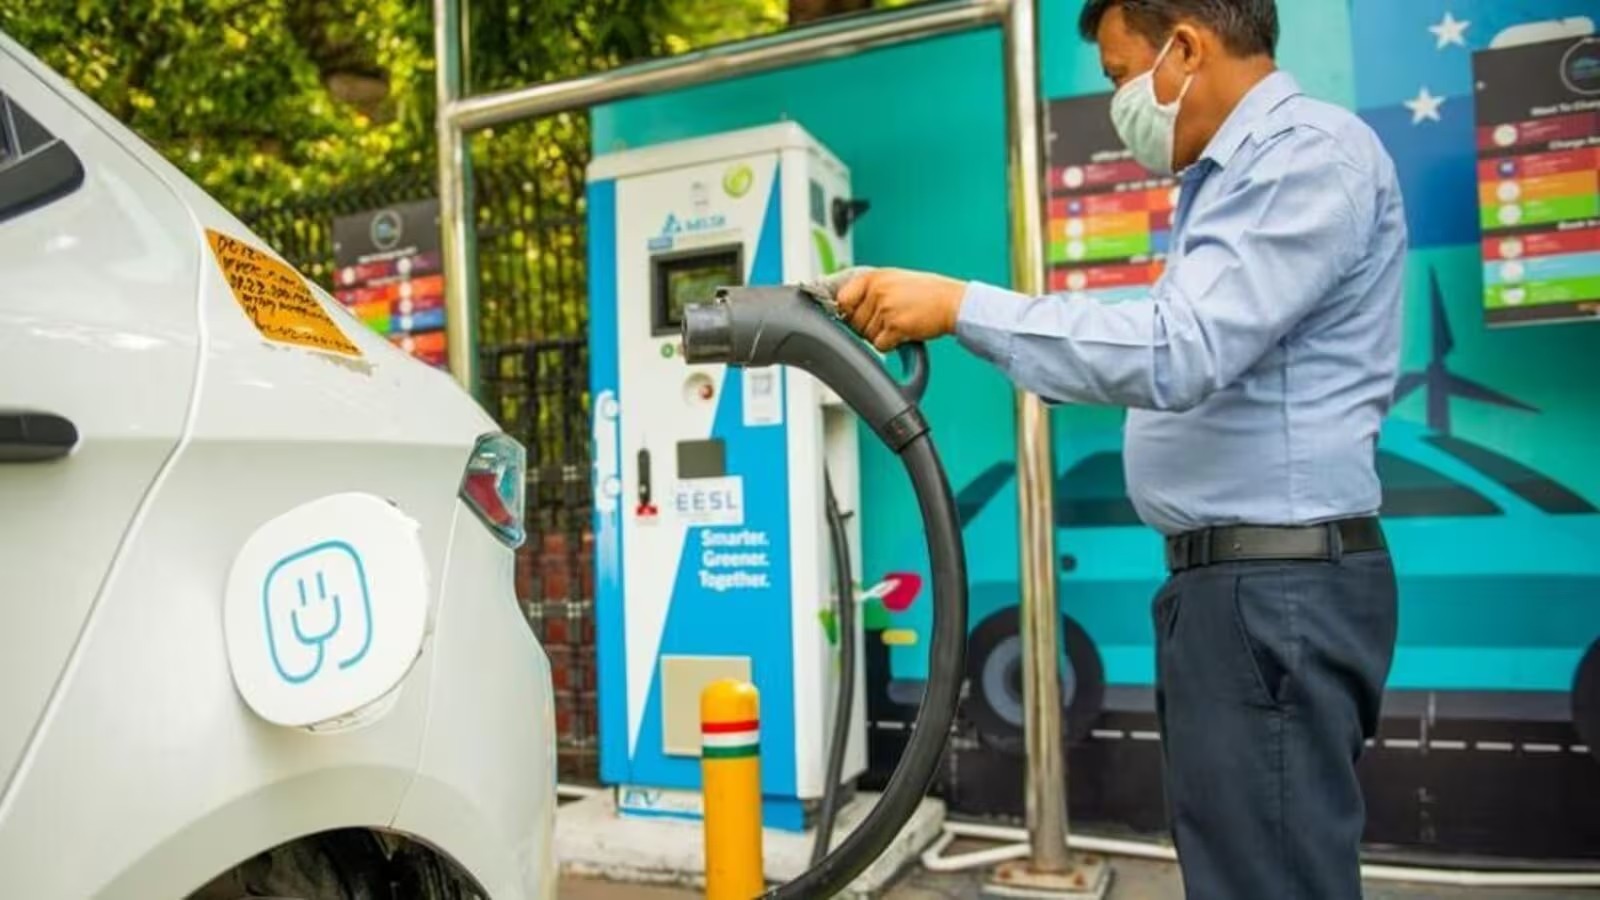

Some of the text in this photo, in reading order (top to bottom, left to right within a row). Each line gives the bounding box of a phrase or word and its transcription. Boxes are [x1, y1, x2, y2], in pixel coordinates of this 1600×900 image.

[676, 489, 737, 512] EESL
[701, 528, 770, 546] Smarter.
[703, 549, 770, 567] Greener.
[698, 569, 771, 592] Together.
